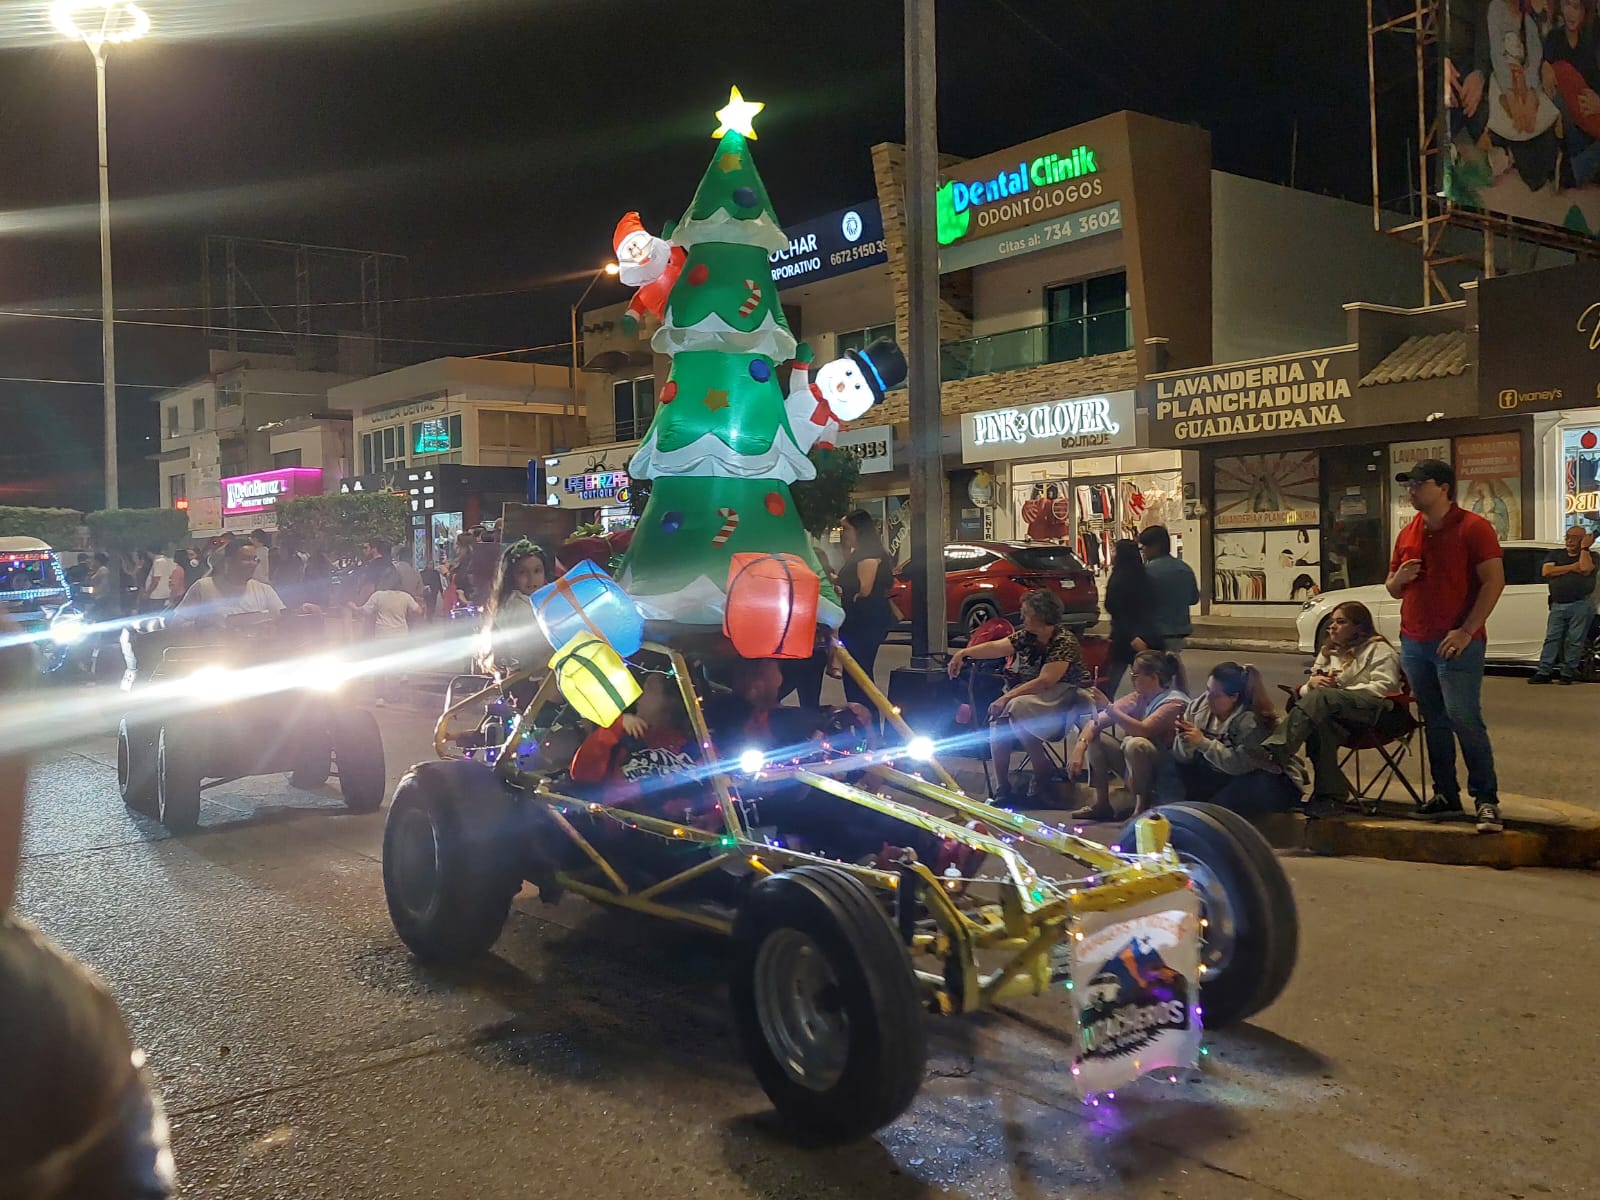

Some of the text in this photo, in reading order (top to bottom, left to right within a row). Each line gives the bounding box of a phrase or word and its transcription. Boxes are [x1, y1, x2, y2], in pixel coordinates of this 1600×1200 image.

[953, 145, 1098, 214] Dental Clinik
[977, 178, 1103, 227] ODONTÓLOGOS
[998, 237, 1026, 254] Citas
[1043, 221, 1072, 241] 734
[1078, 208, 1120, 233] 3602
[771, 257, 821, 281] RPORATIVO
[829, 249, 852, 266] 6672
[852, 242, 876, 259] 5150
[1156, 358, 1330, 400] LAVANDERIA Y
[1156, 378, 1351, 421] PLANCHADURIA
[973, 397, 1120, 445] PINK CLOVER
[1174, 404, 1346, 440] GUADALUPANA
[1061, 433, 1111, 449] BOUTIQUE
[563, 470, 629, 493] LAS GARZAS
[579, 488, 613, 499] BOUTIQUE
